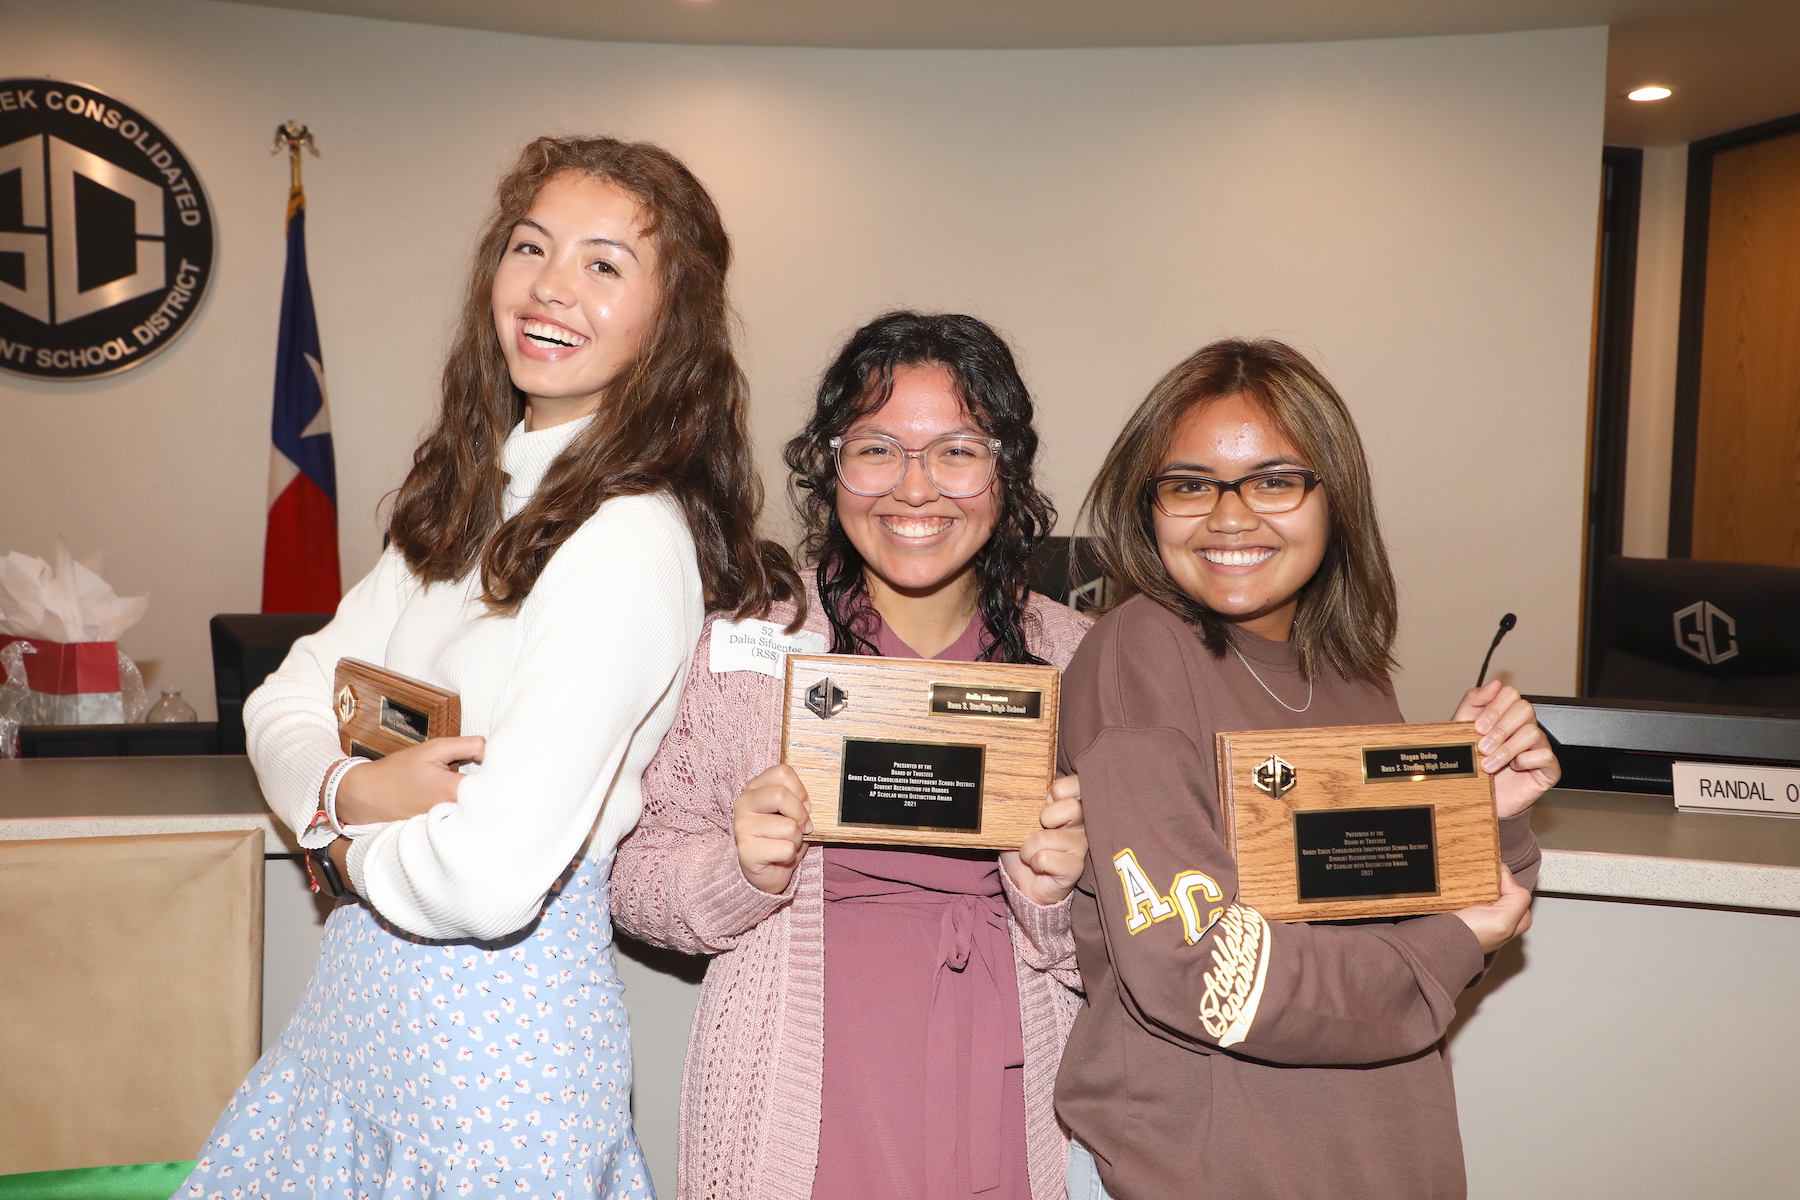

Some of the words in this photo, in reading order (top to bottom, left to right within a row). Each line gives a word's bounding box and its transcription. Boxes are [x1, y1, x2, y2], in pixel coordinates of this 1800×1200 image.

[0, 89, 39, 112] EK
[45, 90, 201, 227] CONSOLIDATED
[36, 336, 138, 369] SCHOOL
[132, 258, 200, 339] DISTRICT
[761, 625, 774, 637] 52
[729, 634, 756, 645] Dalia
[751, 647, 780, 663] (RSS)
[1006, 704, 1027, 714] School
[1381, 764, 1396, 773] Ross
[1425, 761, 1439, 771] High
[1439, 760, 1459, 769] School
[869, 790, 877, 798] AP
[1699, 778, 1775, 802] RANDAL
